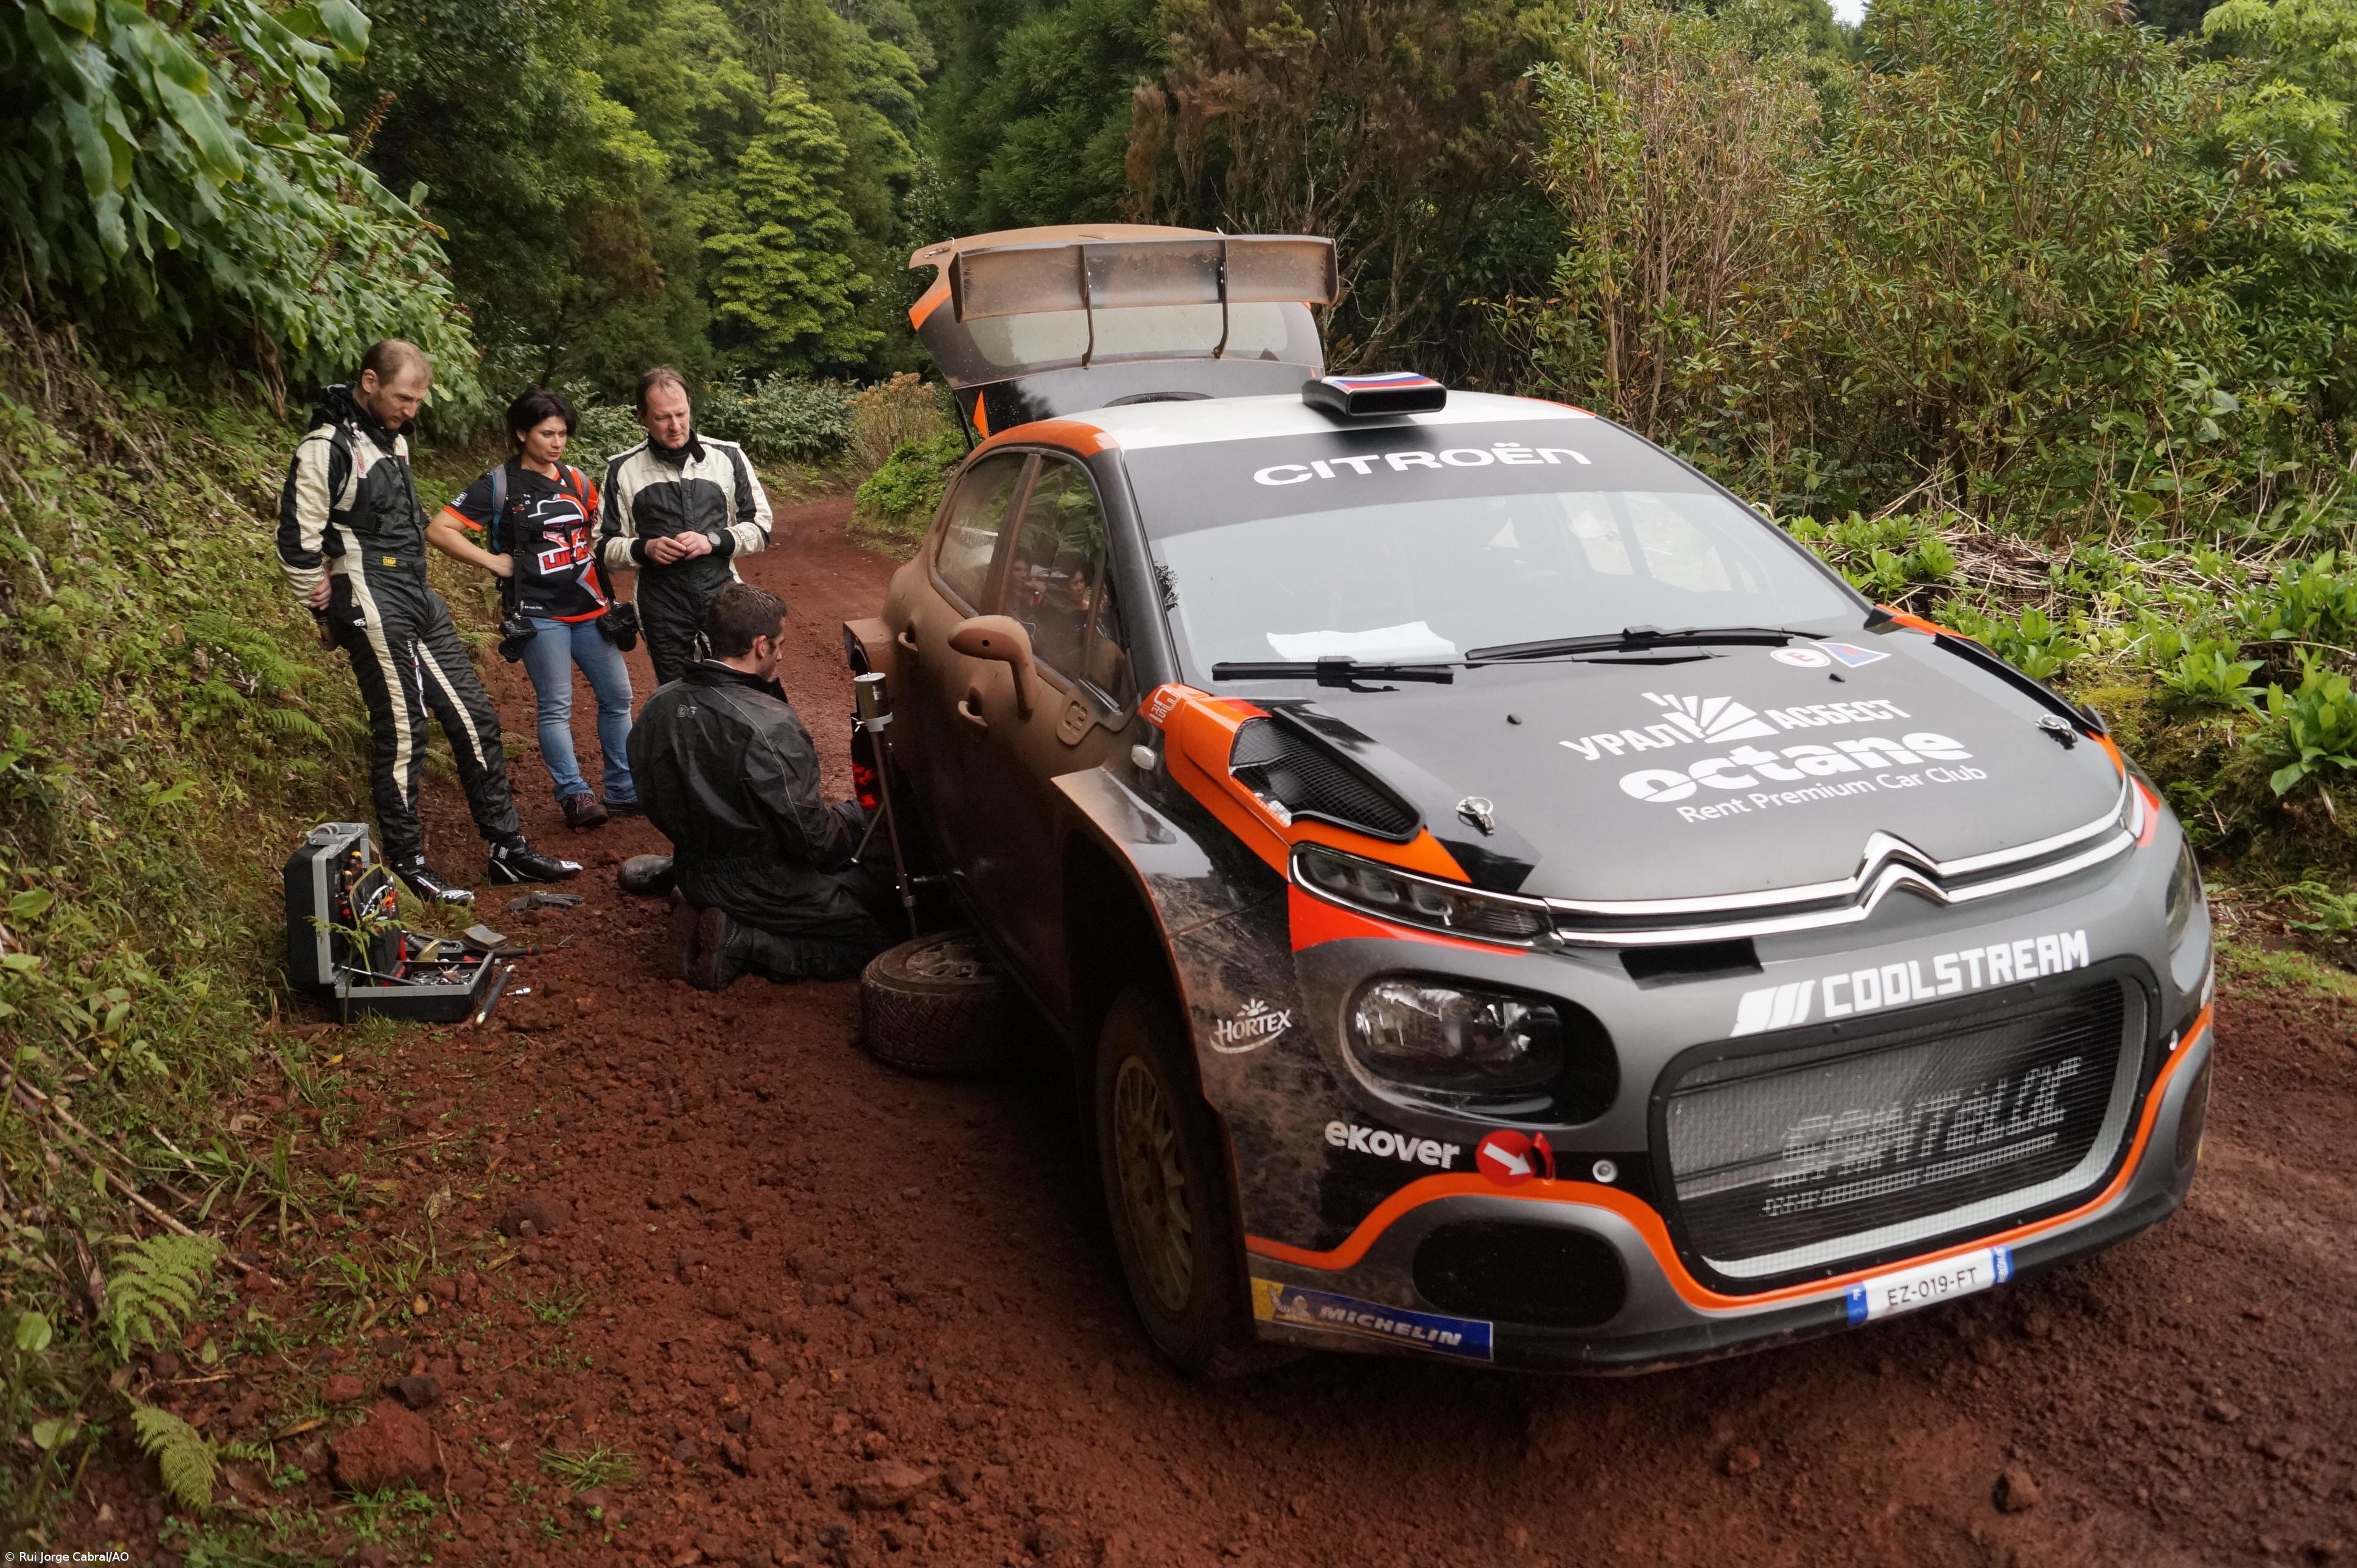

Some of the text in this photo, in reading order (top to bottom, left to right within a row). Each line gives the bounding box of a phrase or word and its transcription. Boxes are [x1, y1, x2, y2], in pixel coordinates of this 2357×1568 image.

[1785, 652, 1816, 662] E
[1558, 699, 1912, 761] УРАЛ АСБЕСТ
[1619, 732, 1974, 803] octane
[1676, 765, 1988, 823] Rent Premium Car Club
[1822, 929, 2089, 1018] COOLSTREAM
[1214, 1008, 1292, 1047] HORTEX
[1324, 1120, 1460, 1169] ekover
[1887, 1267, 1977, 1307] EZ-019-FT
[1318, 1306, 1463, 1346] MICHELIN
